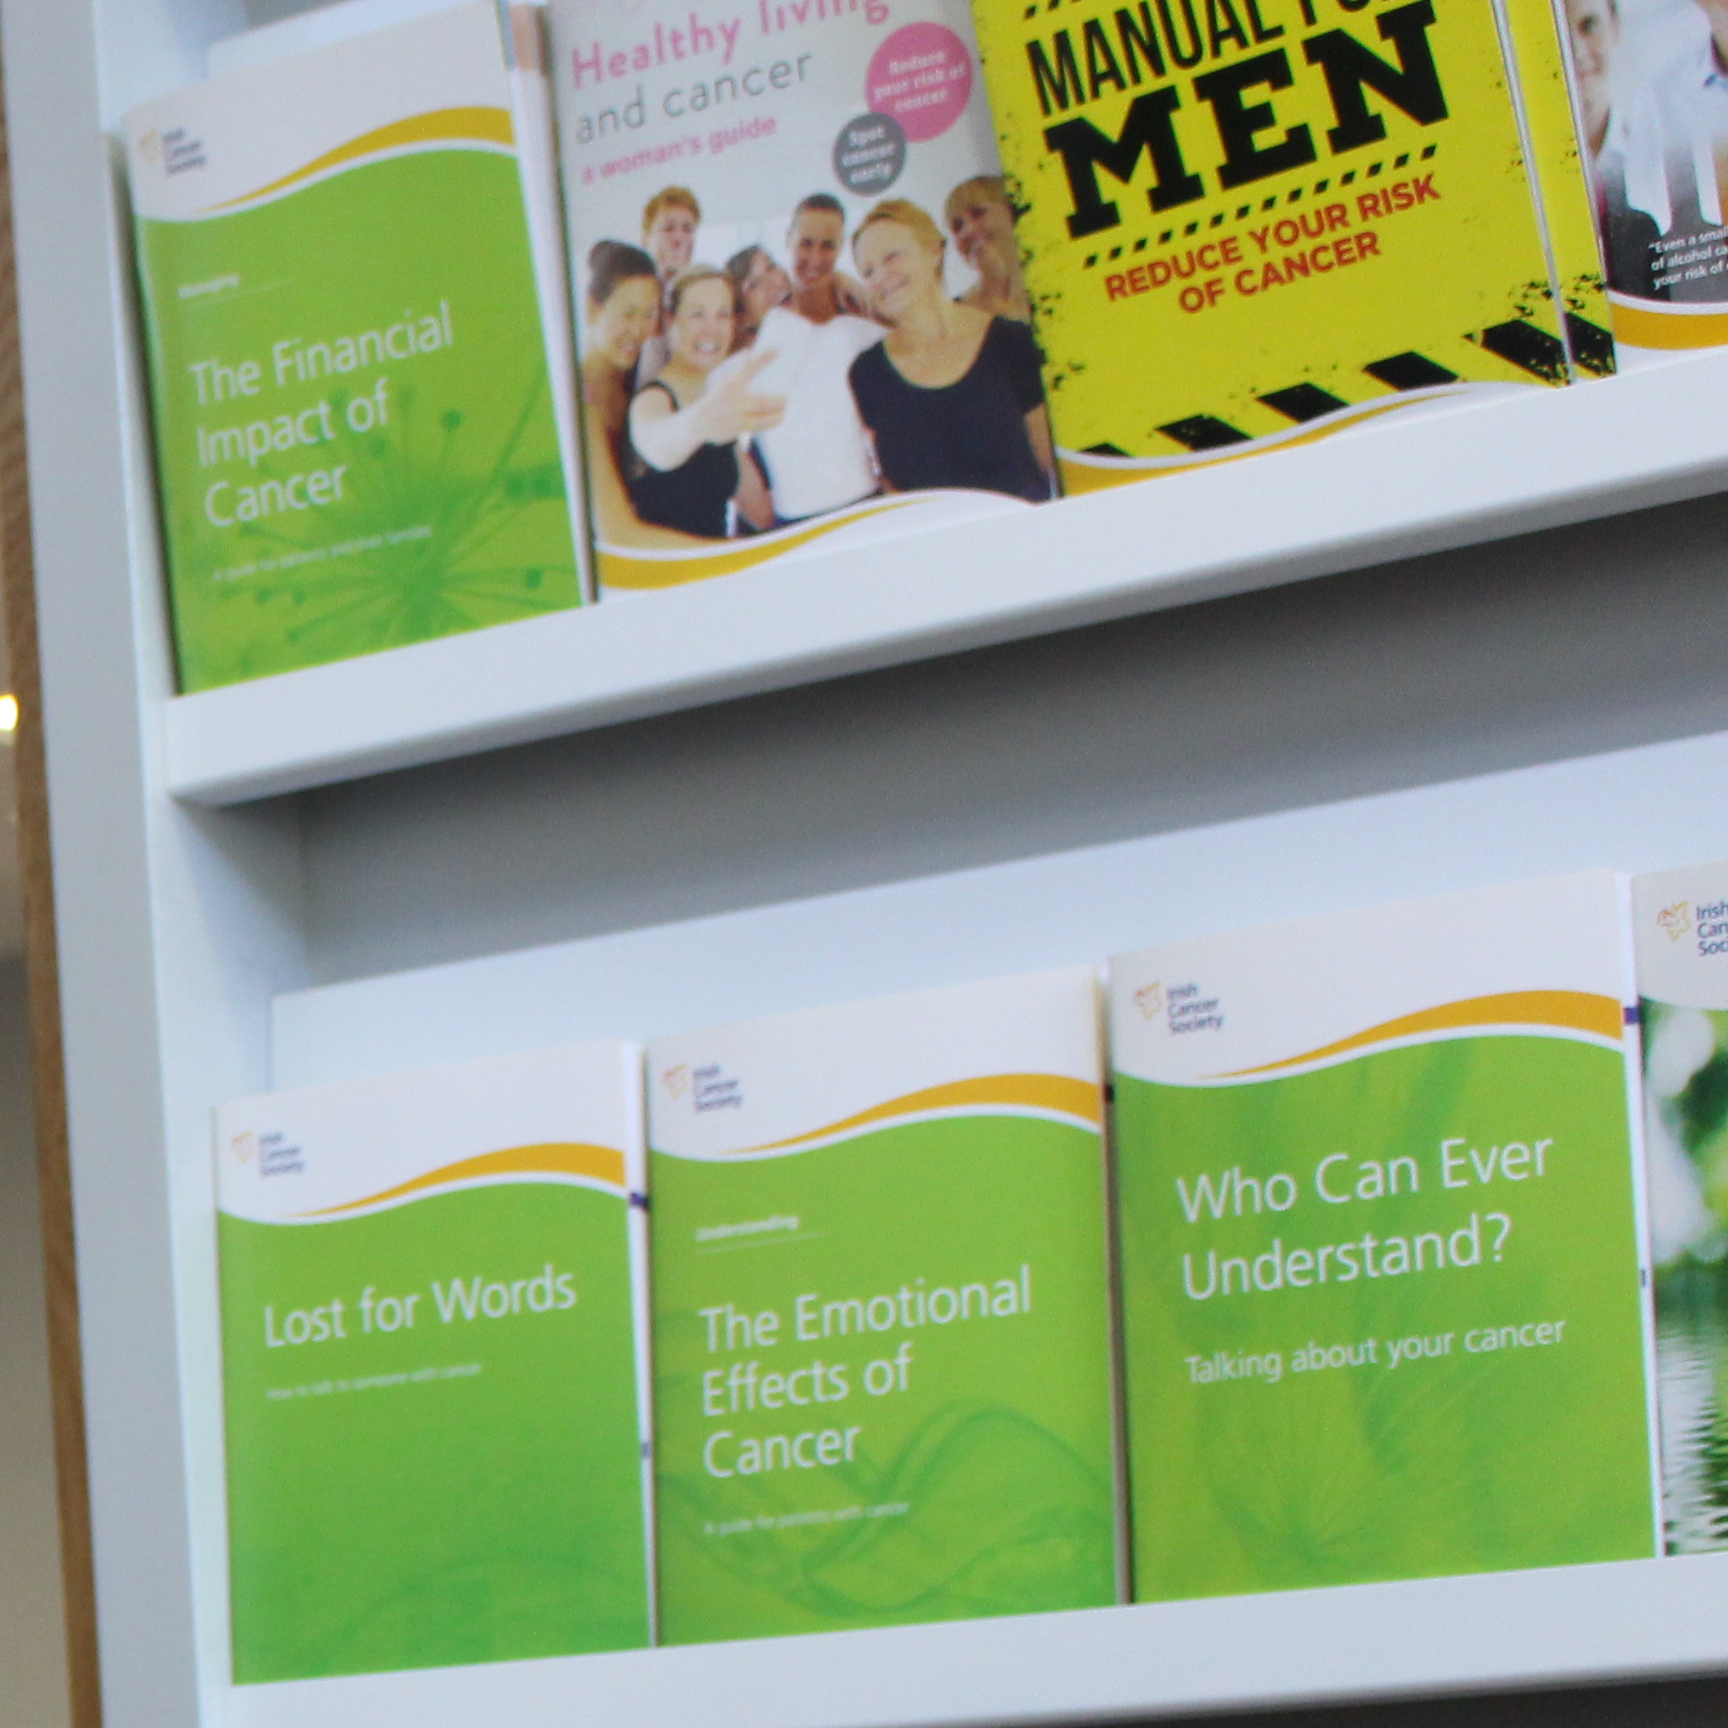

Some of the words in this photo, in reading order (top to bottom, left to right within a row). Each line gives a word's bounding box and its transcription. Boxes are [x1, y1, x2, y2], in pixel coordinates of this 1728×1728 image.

[571, 12, 742, 90] Healthy
[1024, 0, 1285, 118] MANUAL
[576, 84, 644, 144] and
[663, 51, 815, 118] cancer
[1043, 0, 1450, 240] MEN
[600, 135, 702, 179] woman's
[709, 114, 778, 155] guide
[1103, 236, 1244, 301] REDUCE
[1248, 202, 1350, 256] YOUR
[1356, 173, 1441, 223] RISK
[1178, 277, 1225, 314] OF
[1233, 231, 1381, 297] CANCER
[1651, 257, 1664, 271] of
[1667, 245, 1712, 267] alcohol
[188, 356, 261, 406] The
[272, 299, 454, 386] Financial
[196, 401, 337, 468] Impact
[346, 377, 389, 433] of
[204, 464, 348, 527] Cancer
[1176, 1166, 1297, 1223] Who
[1315, 1152, 1419, 1204] Can
[1441, 1137, 1554, 1190] Ever
[1182, 1211, 1512, 1301] Understand?
[264, 1297, 347, 1348] Lost
[359, 1285, 421, 1334] for
[431, 1262, 577, 1324] Words
[698, 1303, 780, 1351] The
[796, 1263, 1032, 1342] Emotional
[702, 1359, 850, 1416] Effects
[863, 1340, 913, 1396] of
[1184, 1347, 1282, 1384] Talking
[1291, 1336, 1378, 1374] about
[1387, 1330, 1456, 1370] your
[1464, 1319, 1566, 1354] cancer
[702, 1425, 862, 1478] Cancer
